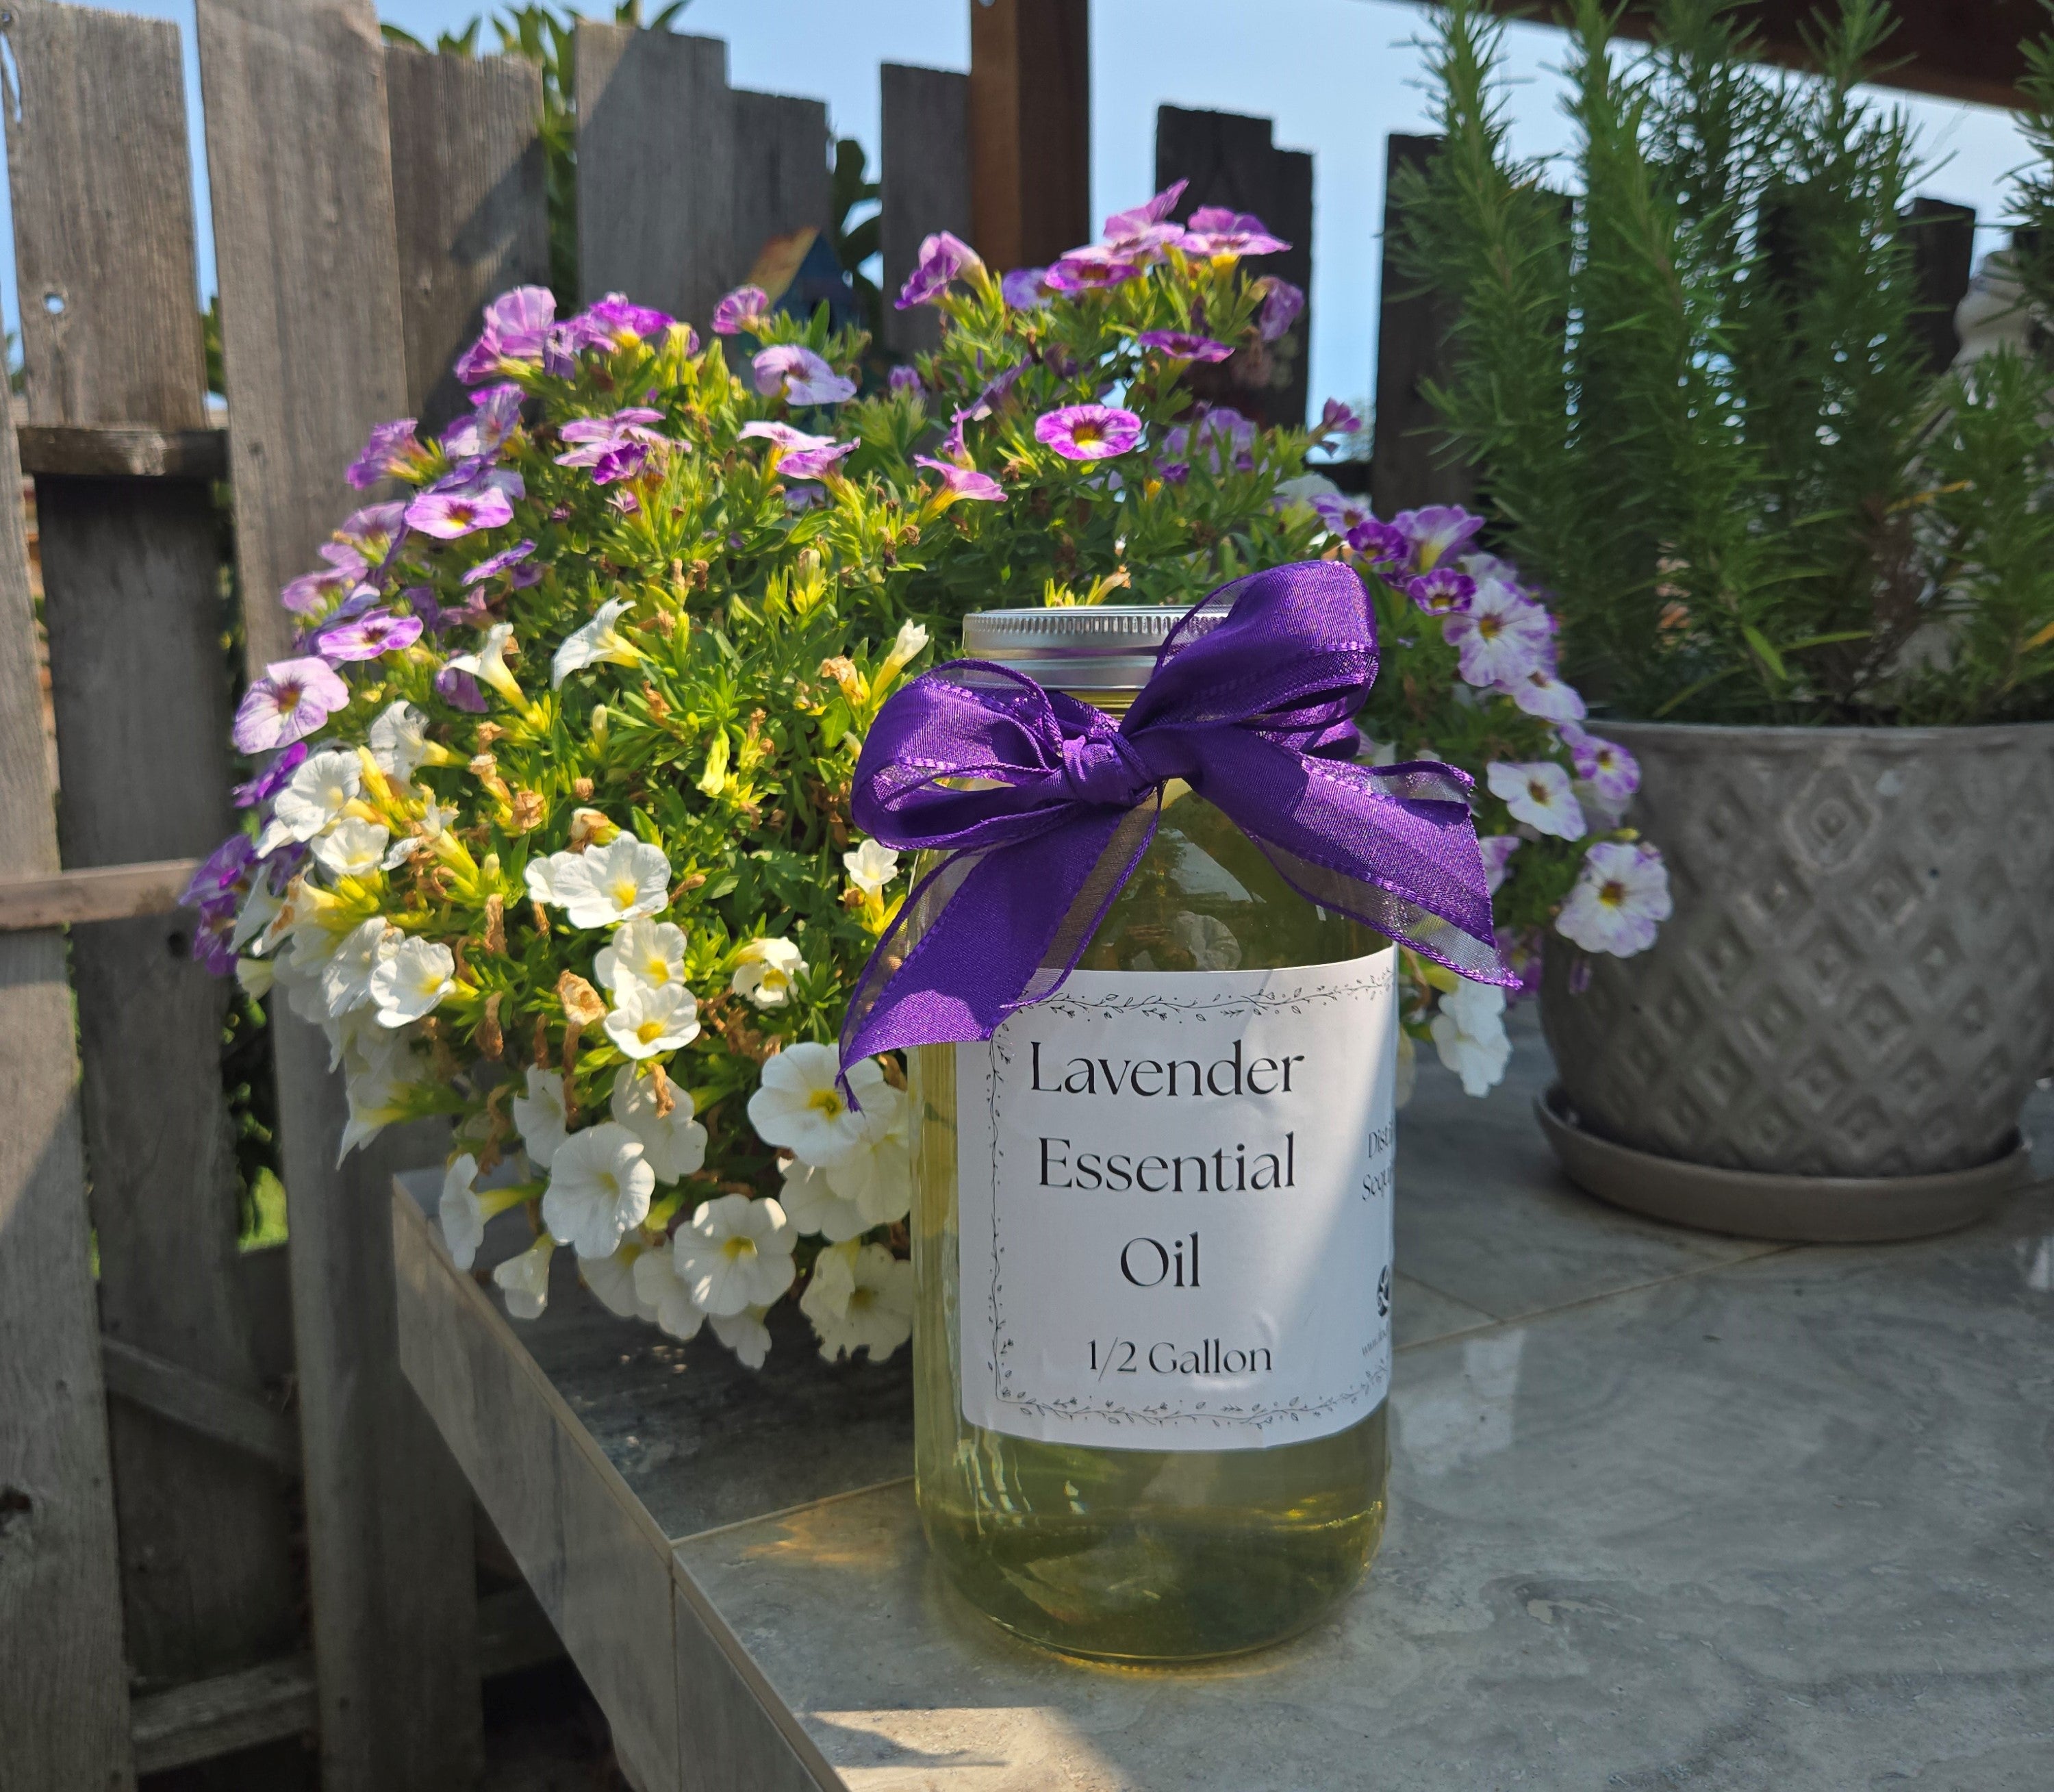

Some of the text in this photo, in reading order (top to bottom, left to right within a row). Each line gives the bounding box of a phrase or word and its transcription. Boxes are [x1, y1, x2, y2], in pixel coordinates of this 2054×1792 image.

[1030, 1039, 1306, 1097] Lavender
[1038, 1131, 1296, 1193] Essential
[1119, 1231, 1201, 1288] Oil
[1087, 1336, 1273, 1382] 1/2 Gallon
